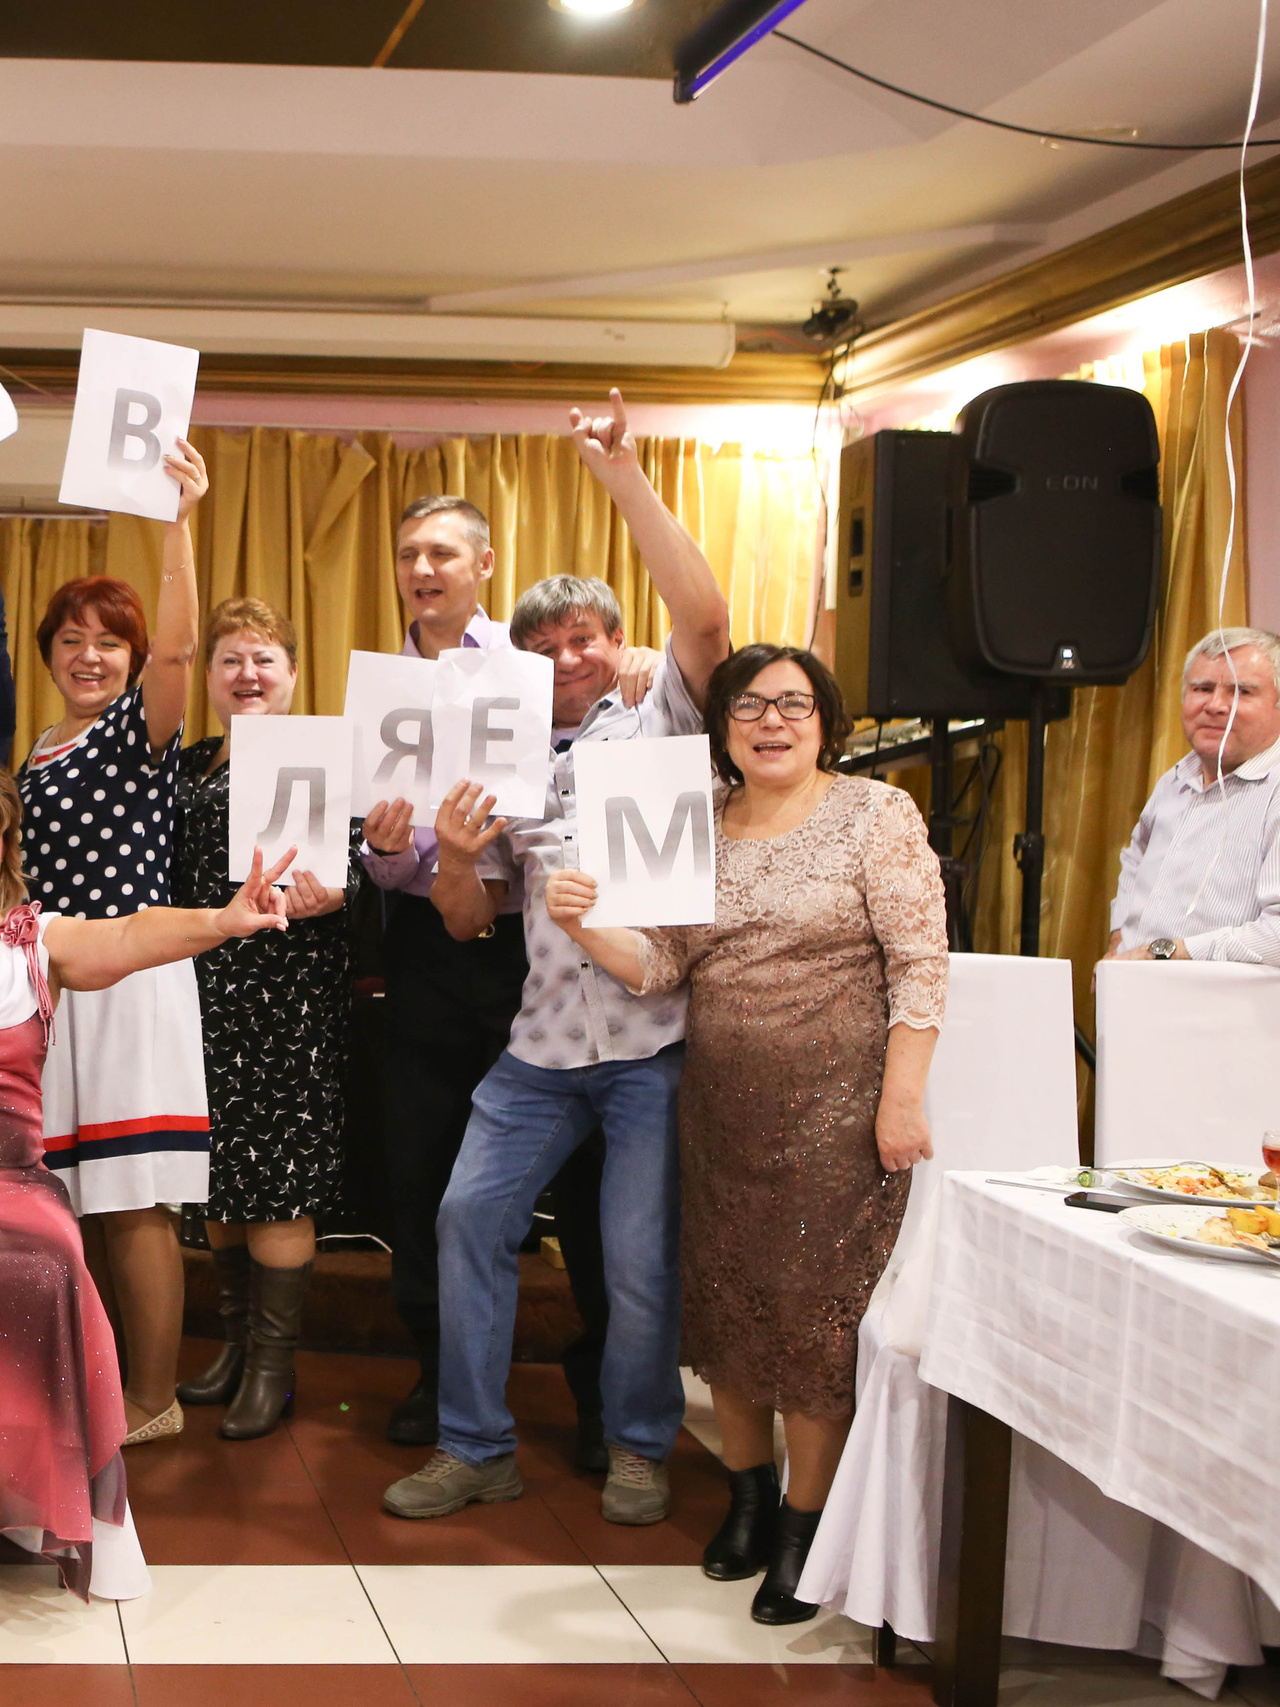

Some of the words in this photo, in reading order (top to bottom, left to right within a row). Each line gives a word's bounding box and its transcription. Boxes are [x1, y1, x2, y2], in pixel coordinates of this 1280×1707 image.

[107, 387, 162, 473] В
[372, 707, 435, 787] Я
[469, 696, 521, 777] Е
[256, 766, 327, 848] Л
[604, 790, 712, 884] М
